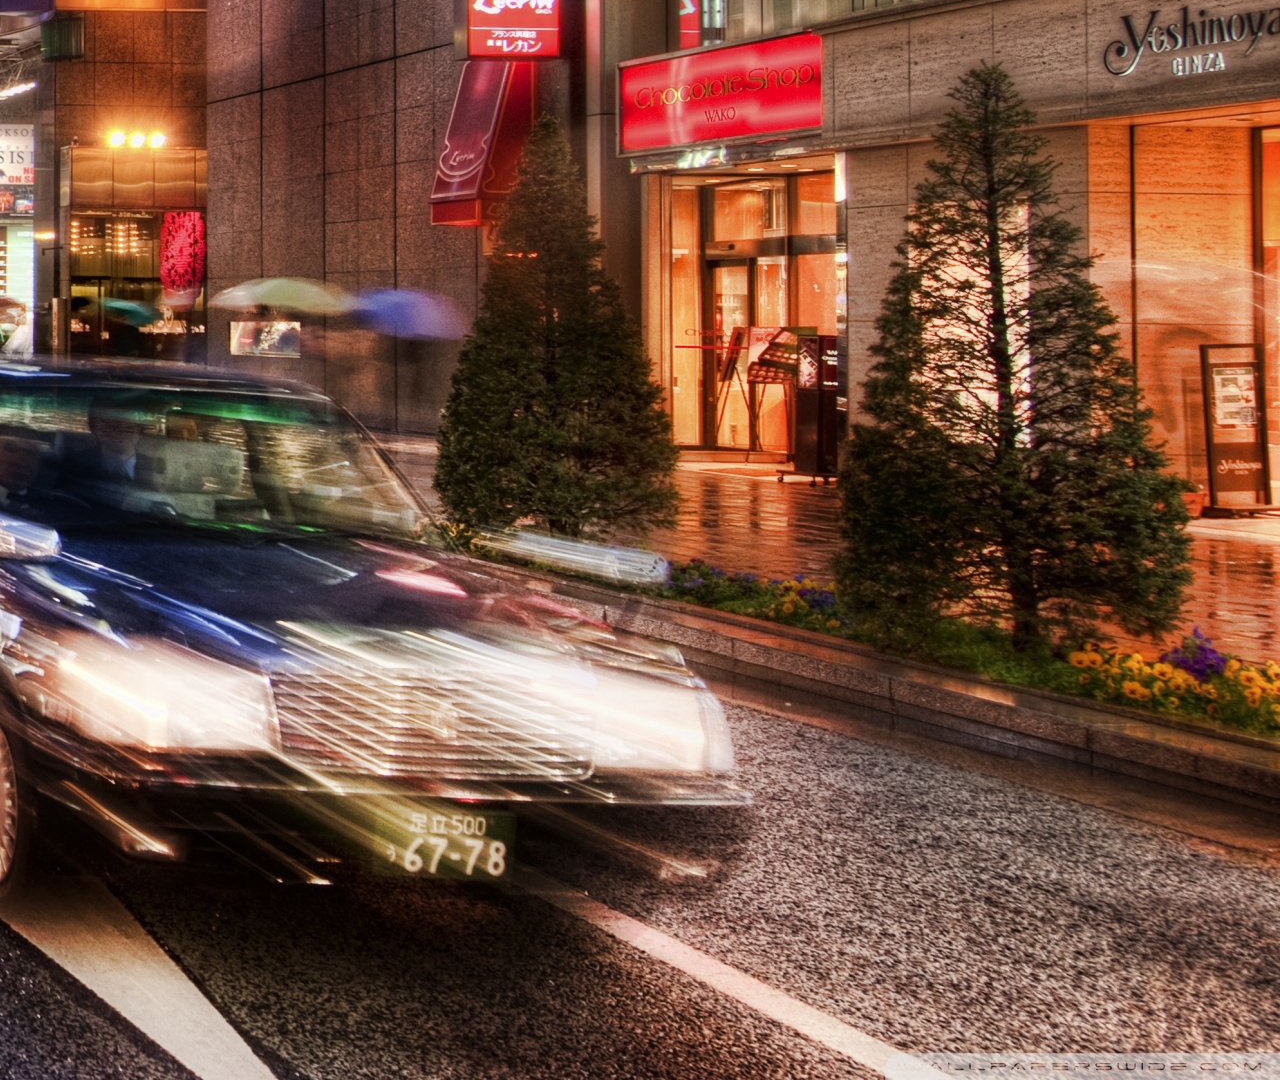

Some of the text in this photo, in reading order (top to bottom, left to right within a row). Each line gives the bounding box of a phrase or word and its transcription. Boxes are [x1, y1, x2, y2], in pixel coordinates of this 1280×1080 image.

[1171, 51, 1226, 76] GINZA
[634, 63, 815, 110] Chocolate Shop
[704, 106, 736, 123] WAKO
[10, 150, 25, 164] IS
[8, 175, 22, 183] ON
[403, 836, 508, 877] 67-78
